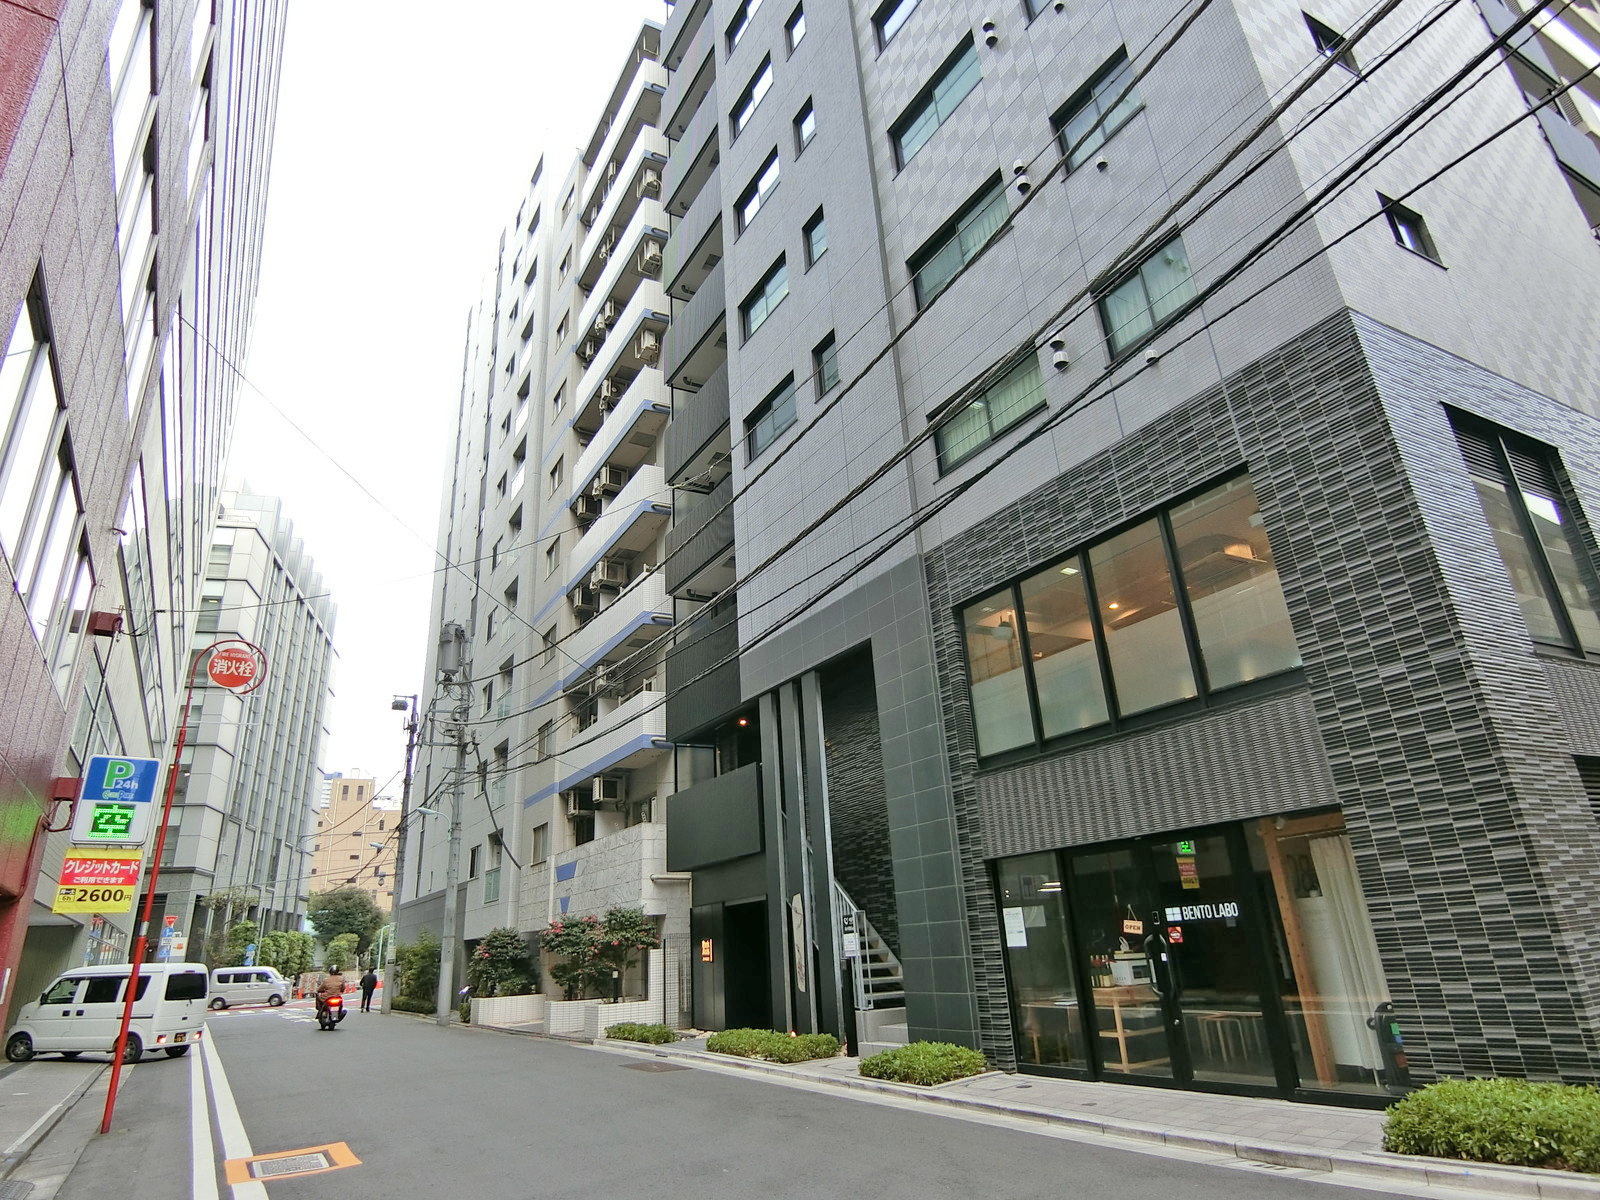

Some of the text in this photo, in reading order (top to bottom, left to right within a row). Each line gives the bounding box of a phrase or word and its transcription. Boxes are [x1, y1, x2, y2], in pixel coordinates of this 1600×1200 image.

[212, 658, 254, 677] 消火栓
[102, 759, 135, 789] P
[115, 780, 138, 790] 24h
[88, 804, 135, 838] 空
[64, 860, 139, 875] クレジットカード
[73, 876, 125, 884] ご利用できます
[1182, 902, 1239, 921] BENTO LABO
